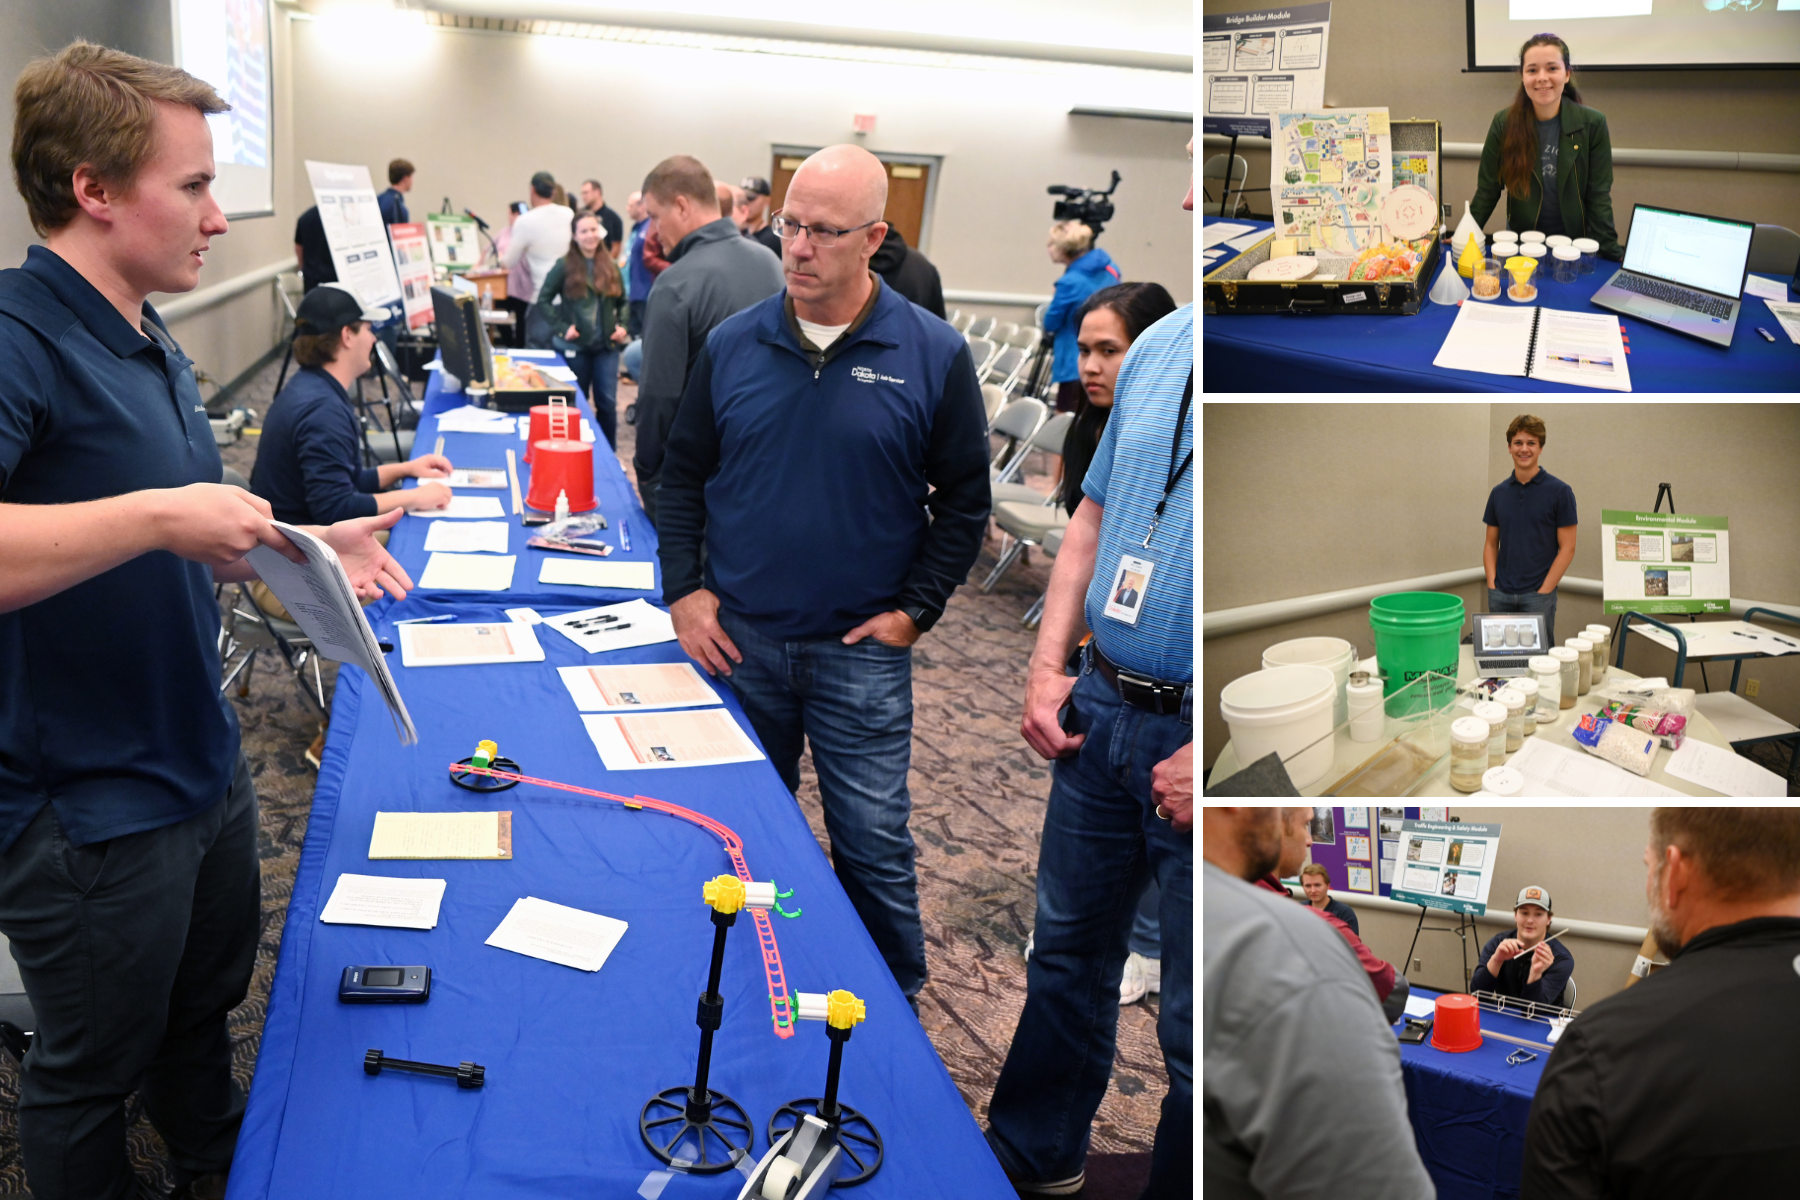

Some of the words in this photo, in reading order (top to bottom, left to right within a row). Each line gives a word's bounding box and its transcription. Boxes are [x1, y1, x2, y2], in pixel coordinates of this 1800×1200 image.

[1226, 16, 1244, 24] Bridge
[1245, 14, 1267, 22] Builder
[1267, 11, 1291, 20] Module
[851, 367, 876, 380] Dakota
[1635, 515, 1676, 523] Environmental
[1427, 823, 1452, 831] Engineering
